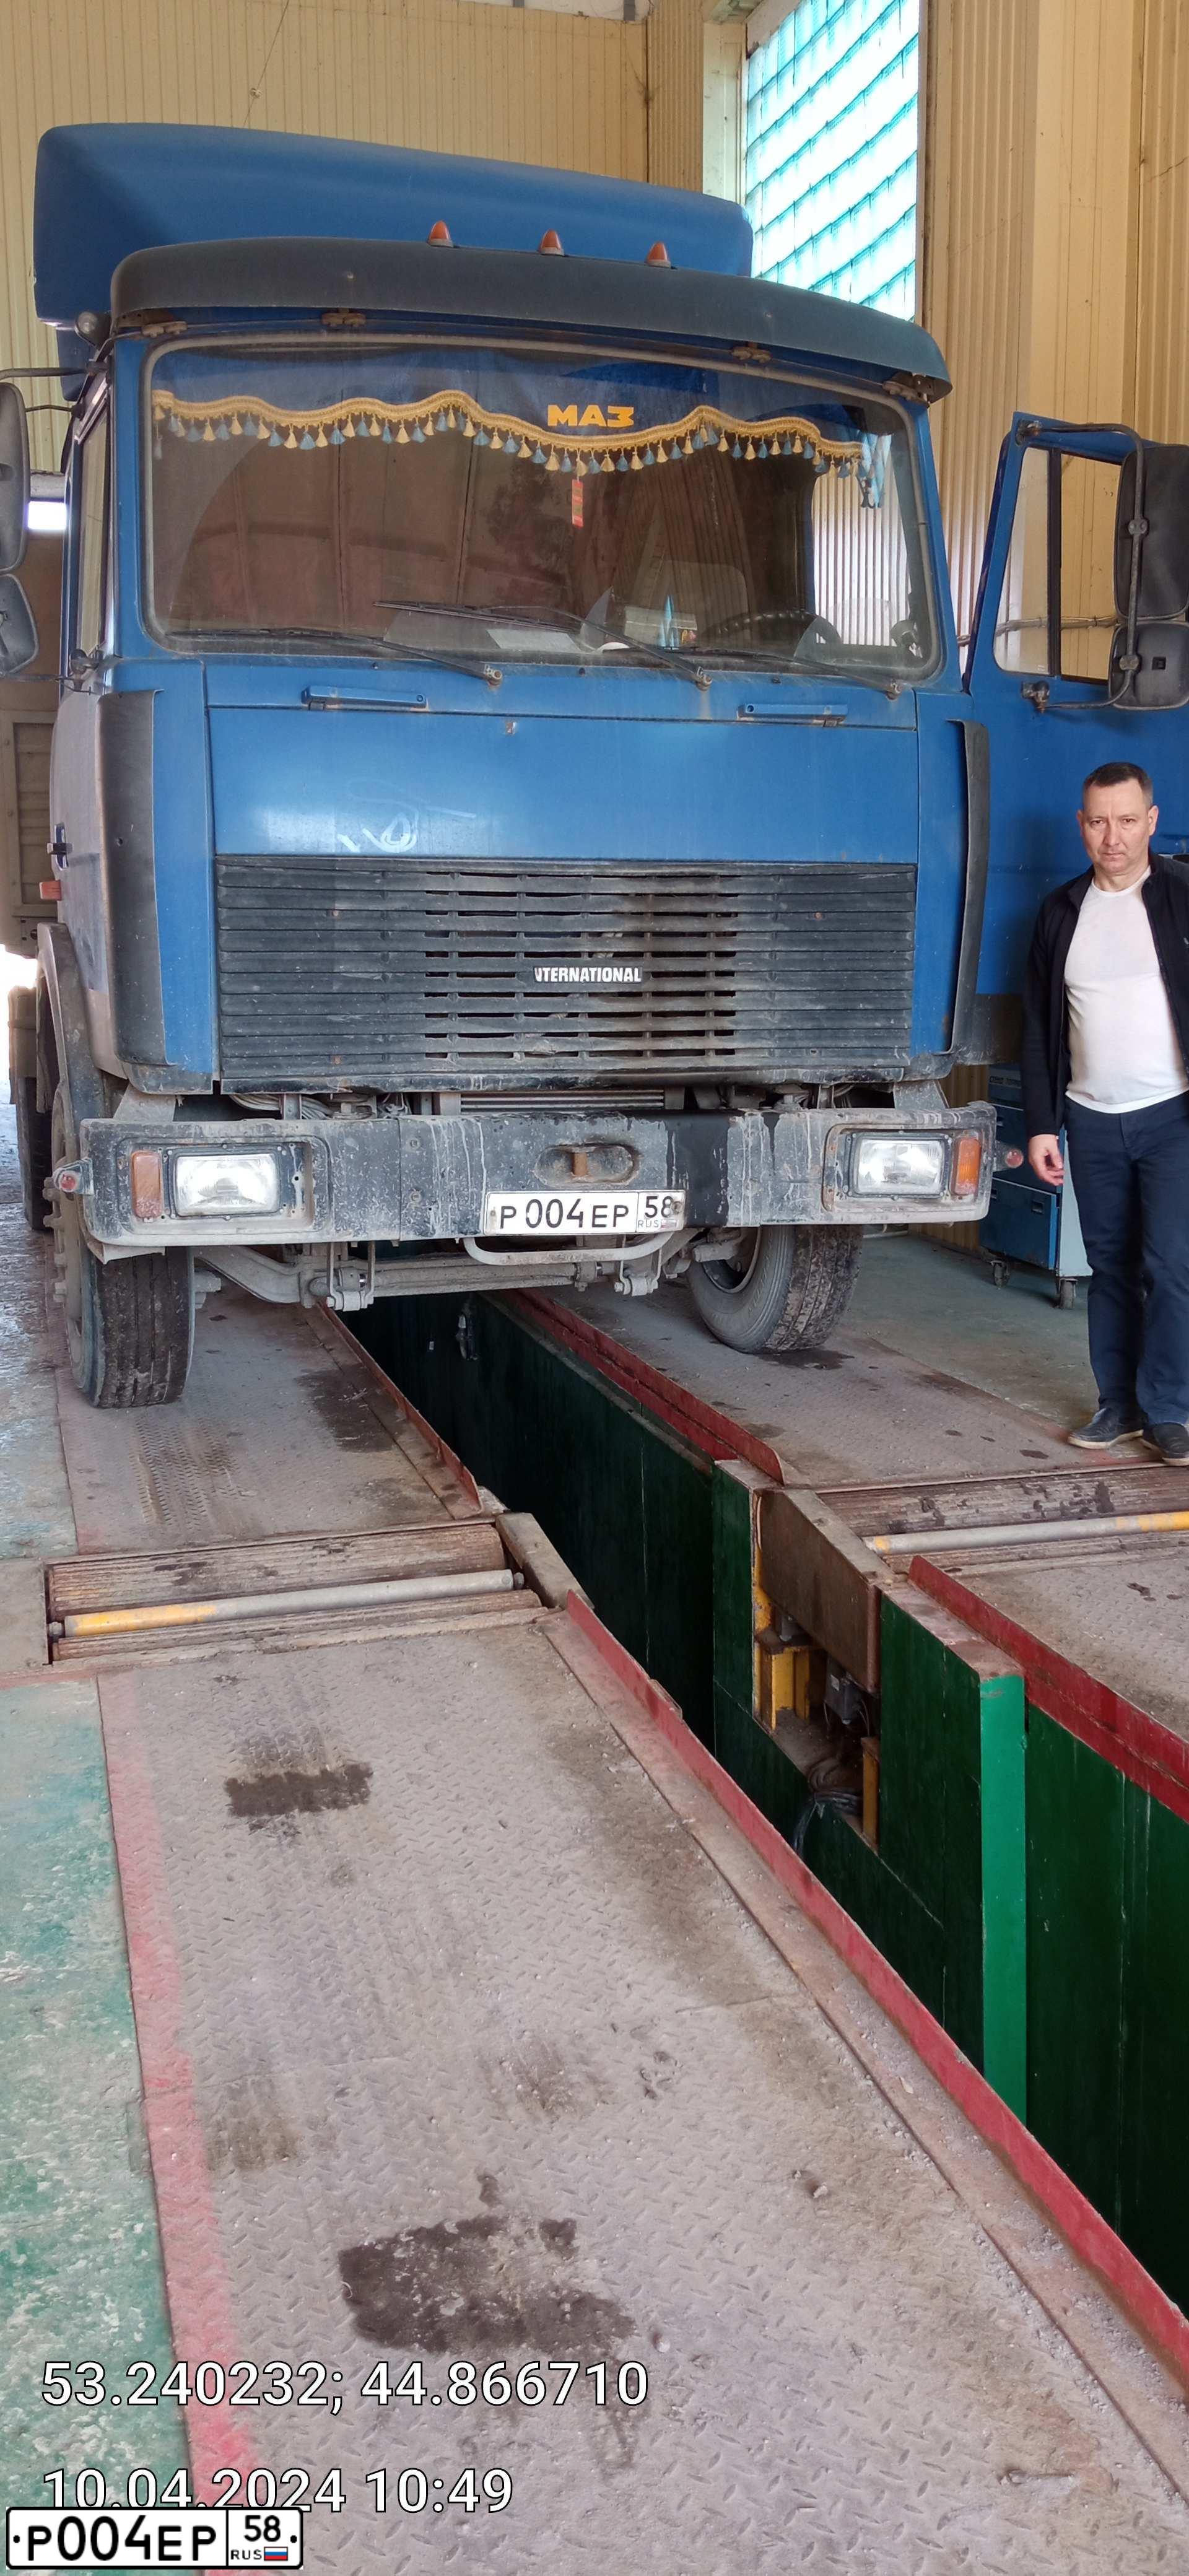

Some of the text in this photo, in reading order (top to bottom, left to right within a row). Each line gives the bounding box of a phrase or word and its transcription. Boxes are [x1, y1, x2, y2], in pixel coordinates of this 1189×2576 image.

[548, 404, 634, 427] МАЗ
[534, 967, 641, 982] NTERNATIONAL
[645, 1196, 674, 1218] 58
[638, 1220, 659, 1228] RUS
